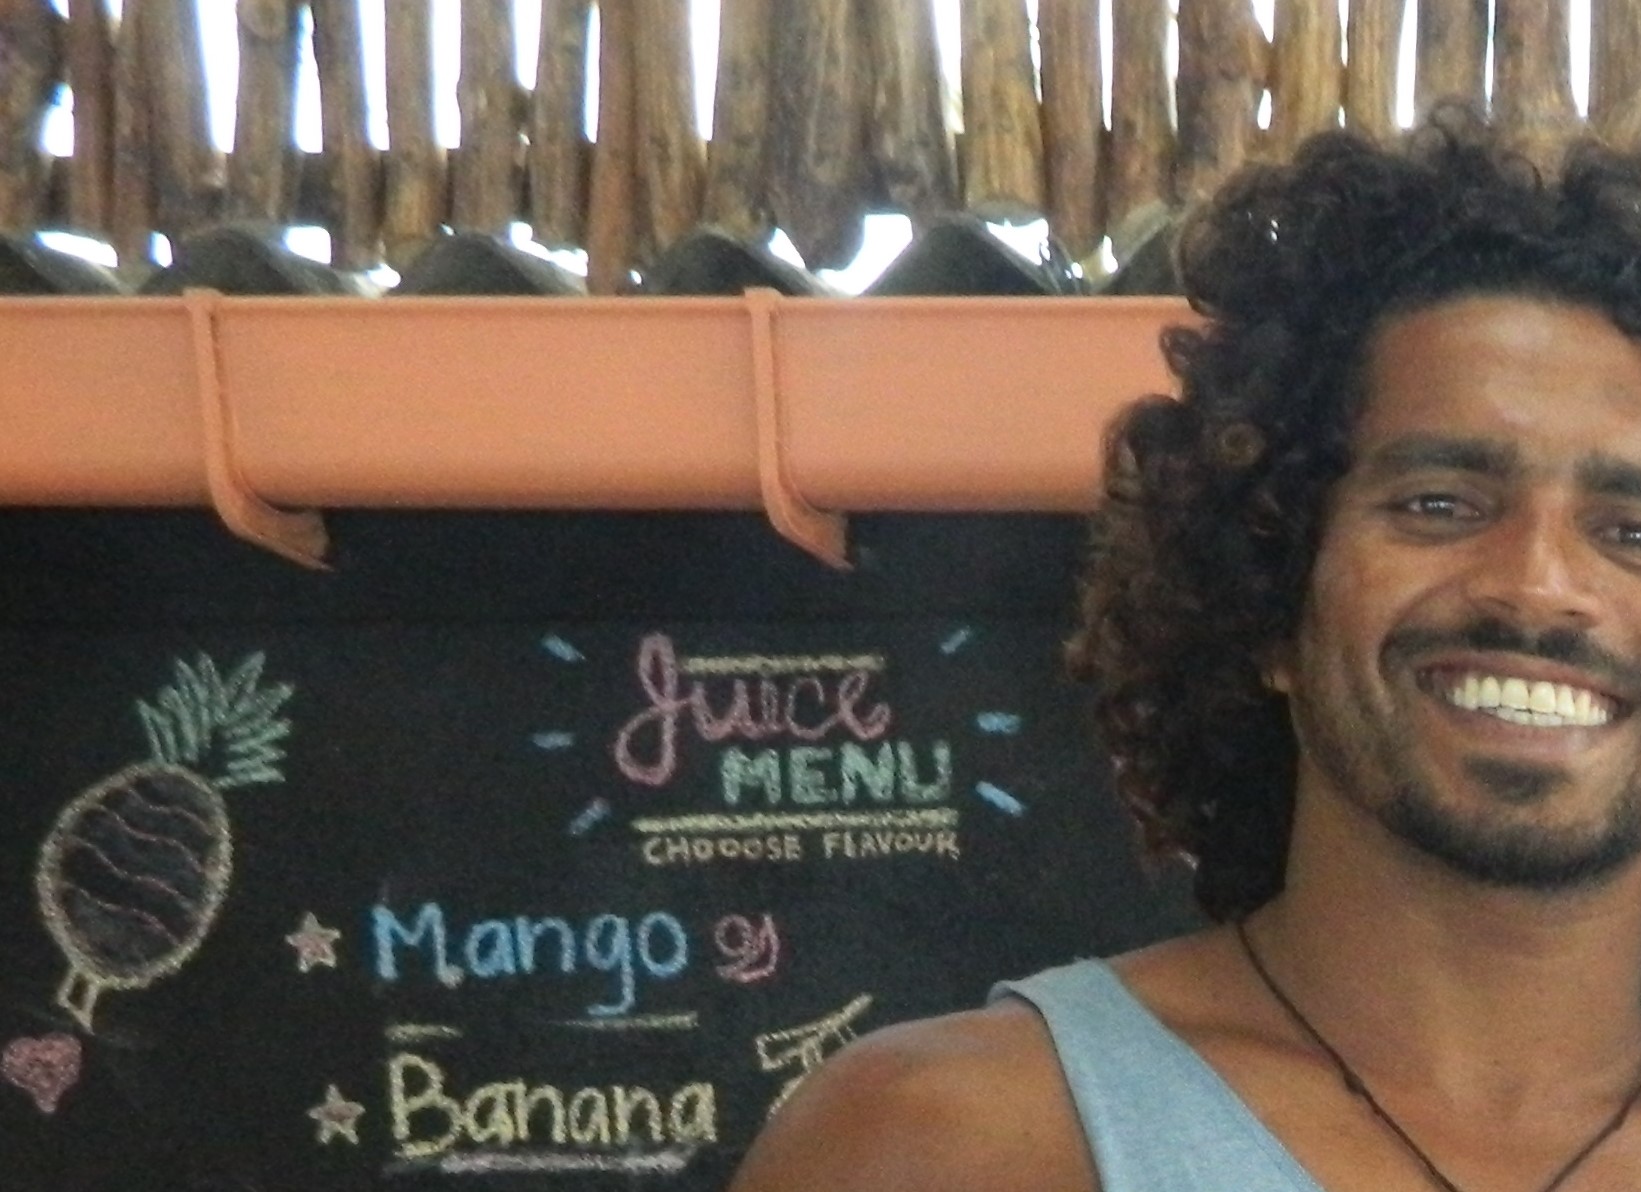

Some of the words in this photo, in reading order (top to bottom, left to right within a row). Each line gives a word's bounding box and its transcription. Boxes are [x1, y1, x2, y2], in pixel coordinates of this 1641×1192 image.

[614, 631, 891, 786] Juice
[718, 739, 952, 806] MENU
[822, 829, 961, 861] FLAVOUR
[369, 902, 689, 1016] Mango
[387, 1052, 718, 1161] Banana
